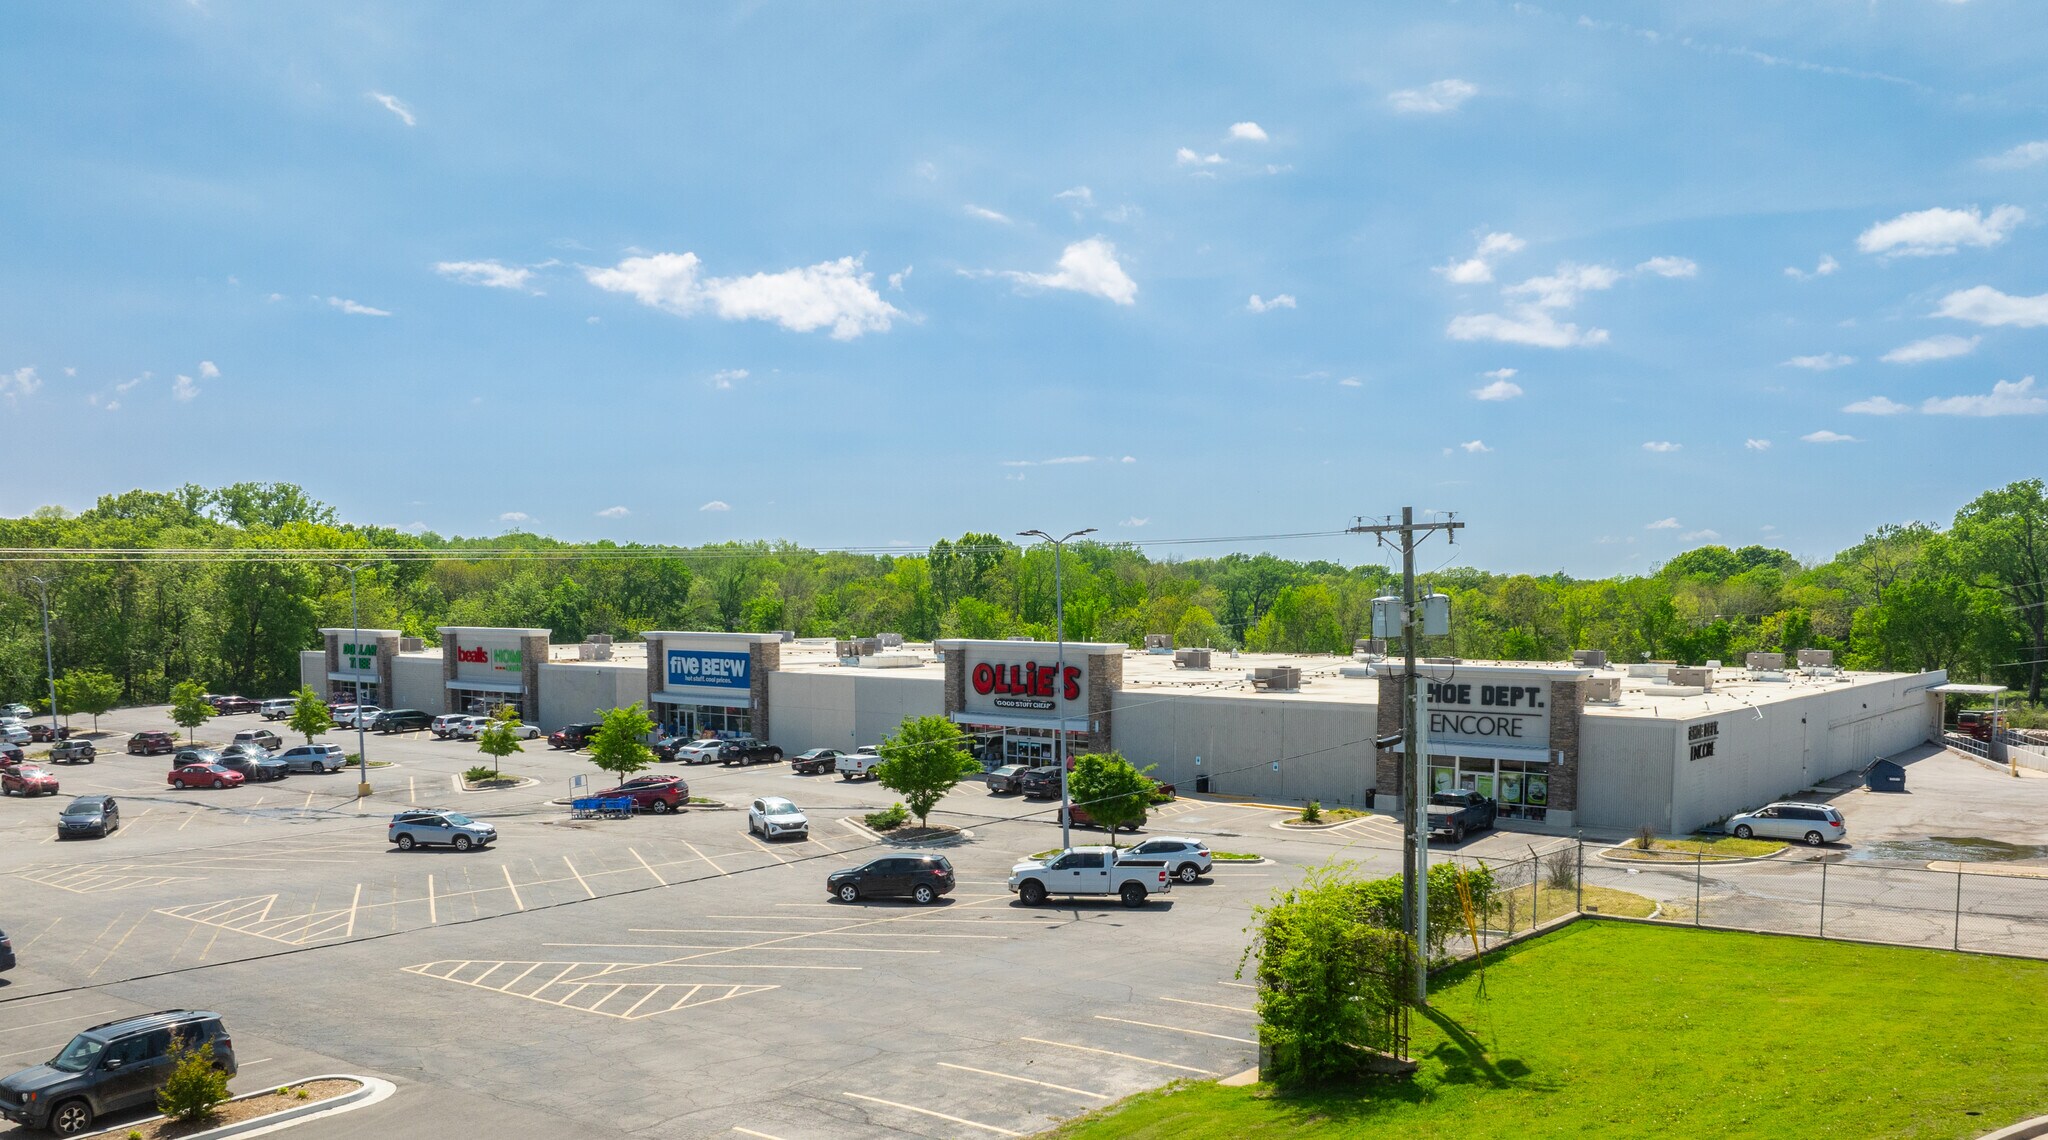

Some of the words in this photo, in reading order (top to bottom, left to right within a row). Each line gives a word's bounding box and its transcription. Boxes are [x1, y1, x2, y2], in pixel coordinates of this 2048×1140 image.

[343, 643, 377, 656] DOLAR
[457, 645, 488, 663] bealls
[349, 657, 371, 669] TEE
[670, 656, 699, 675] five
[1416, 682, 1471, 704] HOE
[1481, 685, 1545, 708] DEPT.
[1430, 713, 1523, 738] ENCORE
